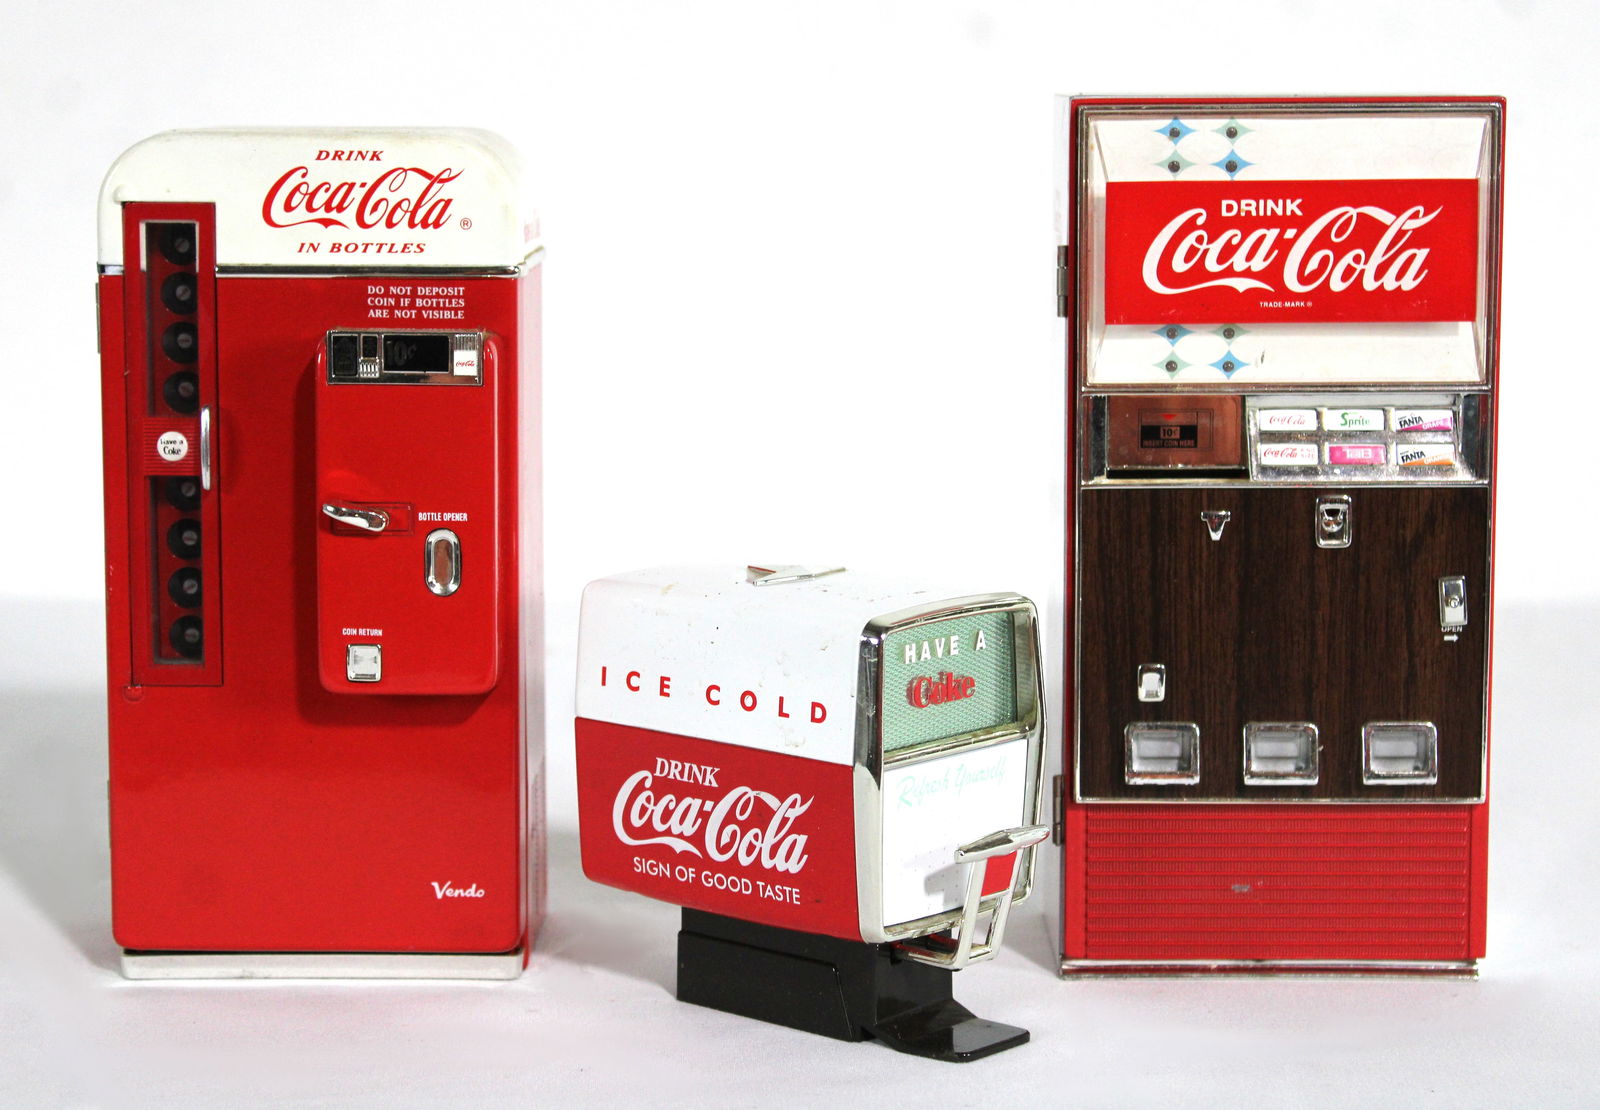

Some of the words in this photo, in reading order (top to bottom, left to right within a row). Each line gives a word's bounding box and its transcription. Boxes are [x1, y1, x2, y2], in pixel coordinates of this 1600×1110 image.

[315, 150, 384, 161] DRINK
[262, 166, 465, 230] Coca-Cola
[1221, 199, 1303, 217] DRINK
[297, 243, 320, 253] IN
[329, 243, 426, 254] BOTTLES
[1142, 205, 1443, 295] Coca-Cola
[367, 285, 384, 295] DO
[389, 286, 412, 296] NOT
[417, 286, 465, 296] DEPOSIT
[367, 297, 395, 307] COIN
[400, 298, 411, 307] IF
[415, 298, 465, 307] BOTTLES
[1259, 300, 1305, 308] TRADE-MARK
[368, 309, 389, 318] ARE
[394, 309, 417, 319] NOT
[422, 310, 465, 319] VISIBLE
[1340, 412, 1370, 428] Sprite
[1399, 416, 1424, 428] FANTA
[163, 446, 182, 455] Coke
[1401, 450, 1426, 463] FANTA
[418, 511, 442, 521] BOTTLE
[443, 512, 468, 522] OPENER
[342, 627, 357, 636] COIN
[358, 628, 383, 637] RETURN
[905, 635, 959, 665] HAVE
[975, 630, 987, 651] A
[601, 666, 671, 698] ICE
[705, 684, 827, 724] COLD
[912, 671, 976, 708] Coke
[654, 757, 720, 787] DRINK
[612, 770, 815, 874] Coca-Cola
[633, 856, 671, 879] SIGN
[675, 865, 696, 883] OF
[701, 871, 752, 895] GOOD
[756, 881, 801, 905] TASTE
[431, 880, 485, 900] Vendo
